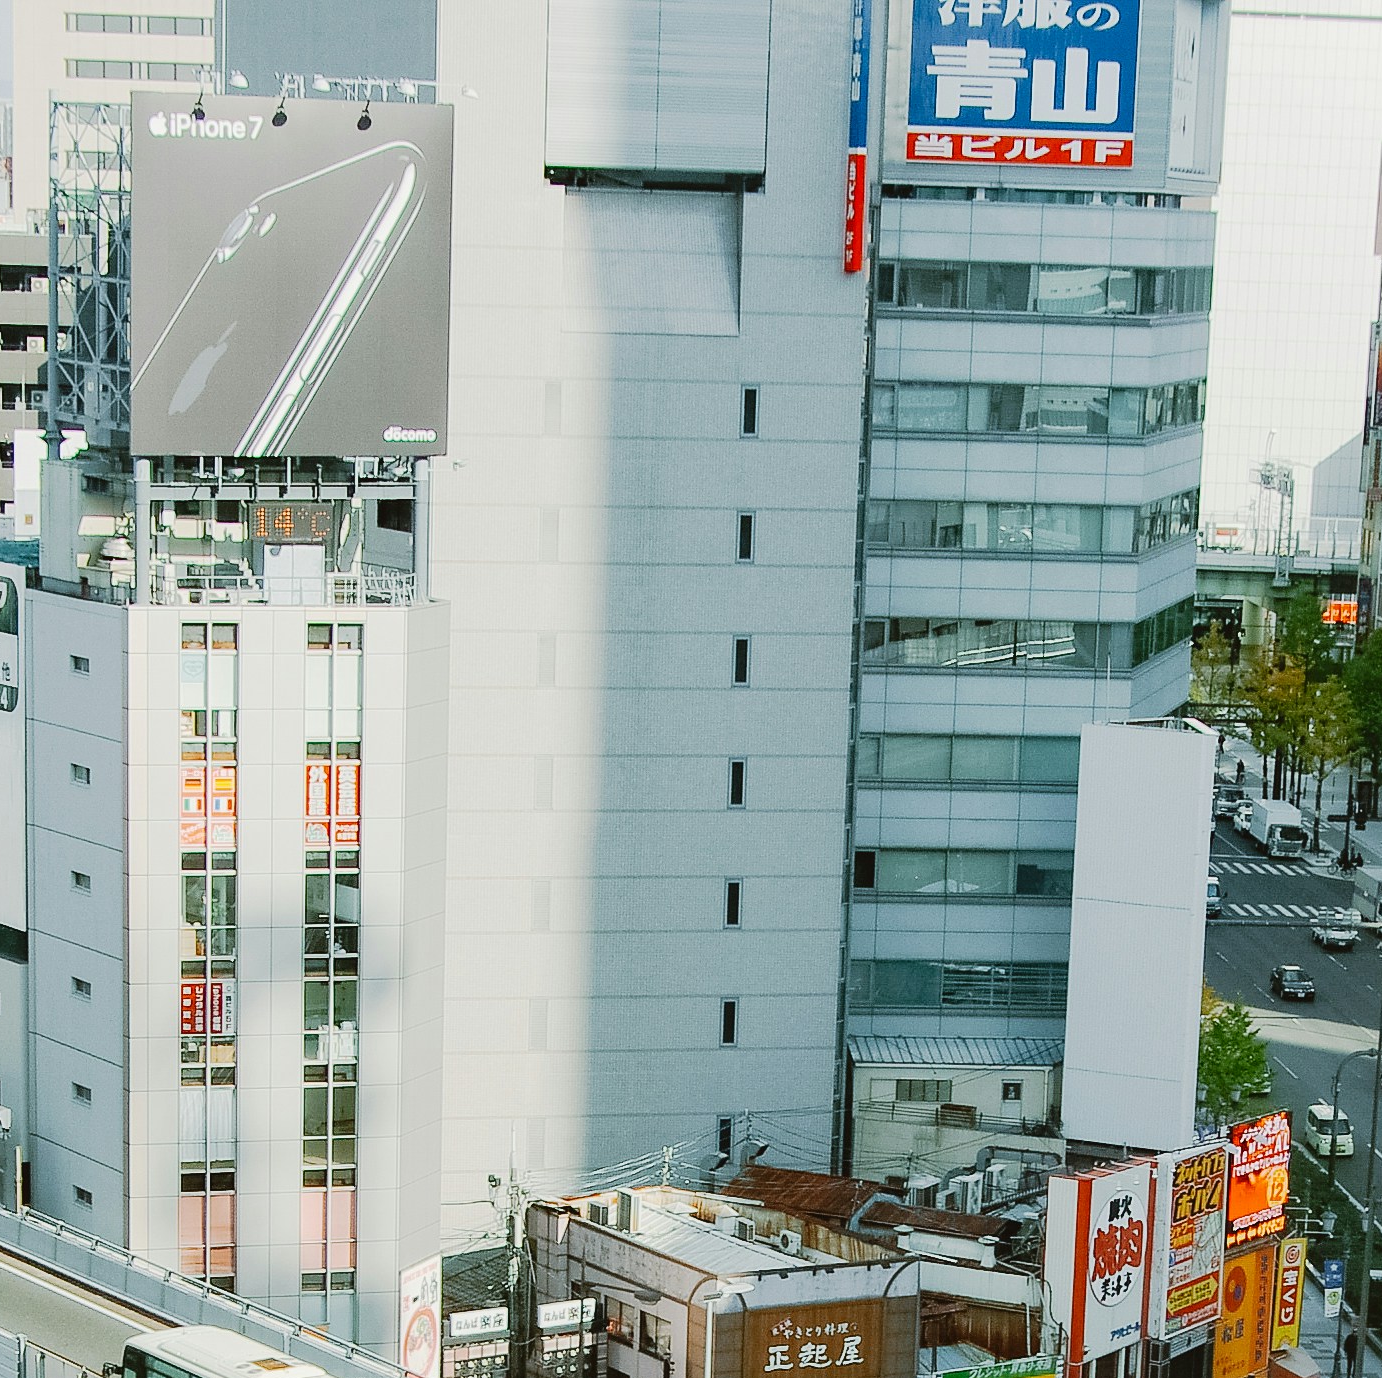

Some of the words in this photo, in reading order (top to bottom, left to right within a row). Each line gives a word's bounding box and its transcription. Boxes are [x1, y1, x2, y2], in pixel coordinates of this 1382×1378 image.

[926, 39, 1121, 124] 青山
[169, 112, 246, 138] iPhone
[248, 115, 263, 139] 7
[914, 134, 1125, 163] 当ビル1F
[1092, 1217, 1144, 1282] 焼肉
[1280, 1269, 1299, 1323] 宝くじ
[764, 1335, 865, 1372] 正起屋
